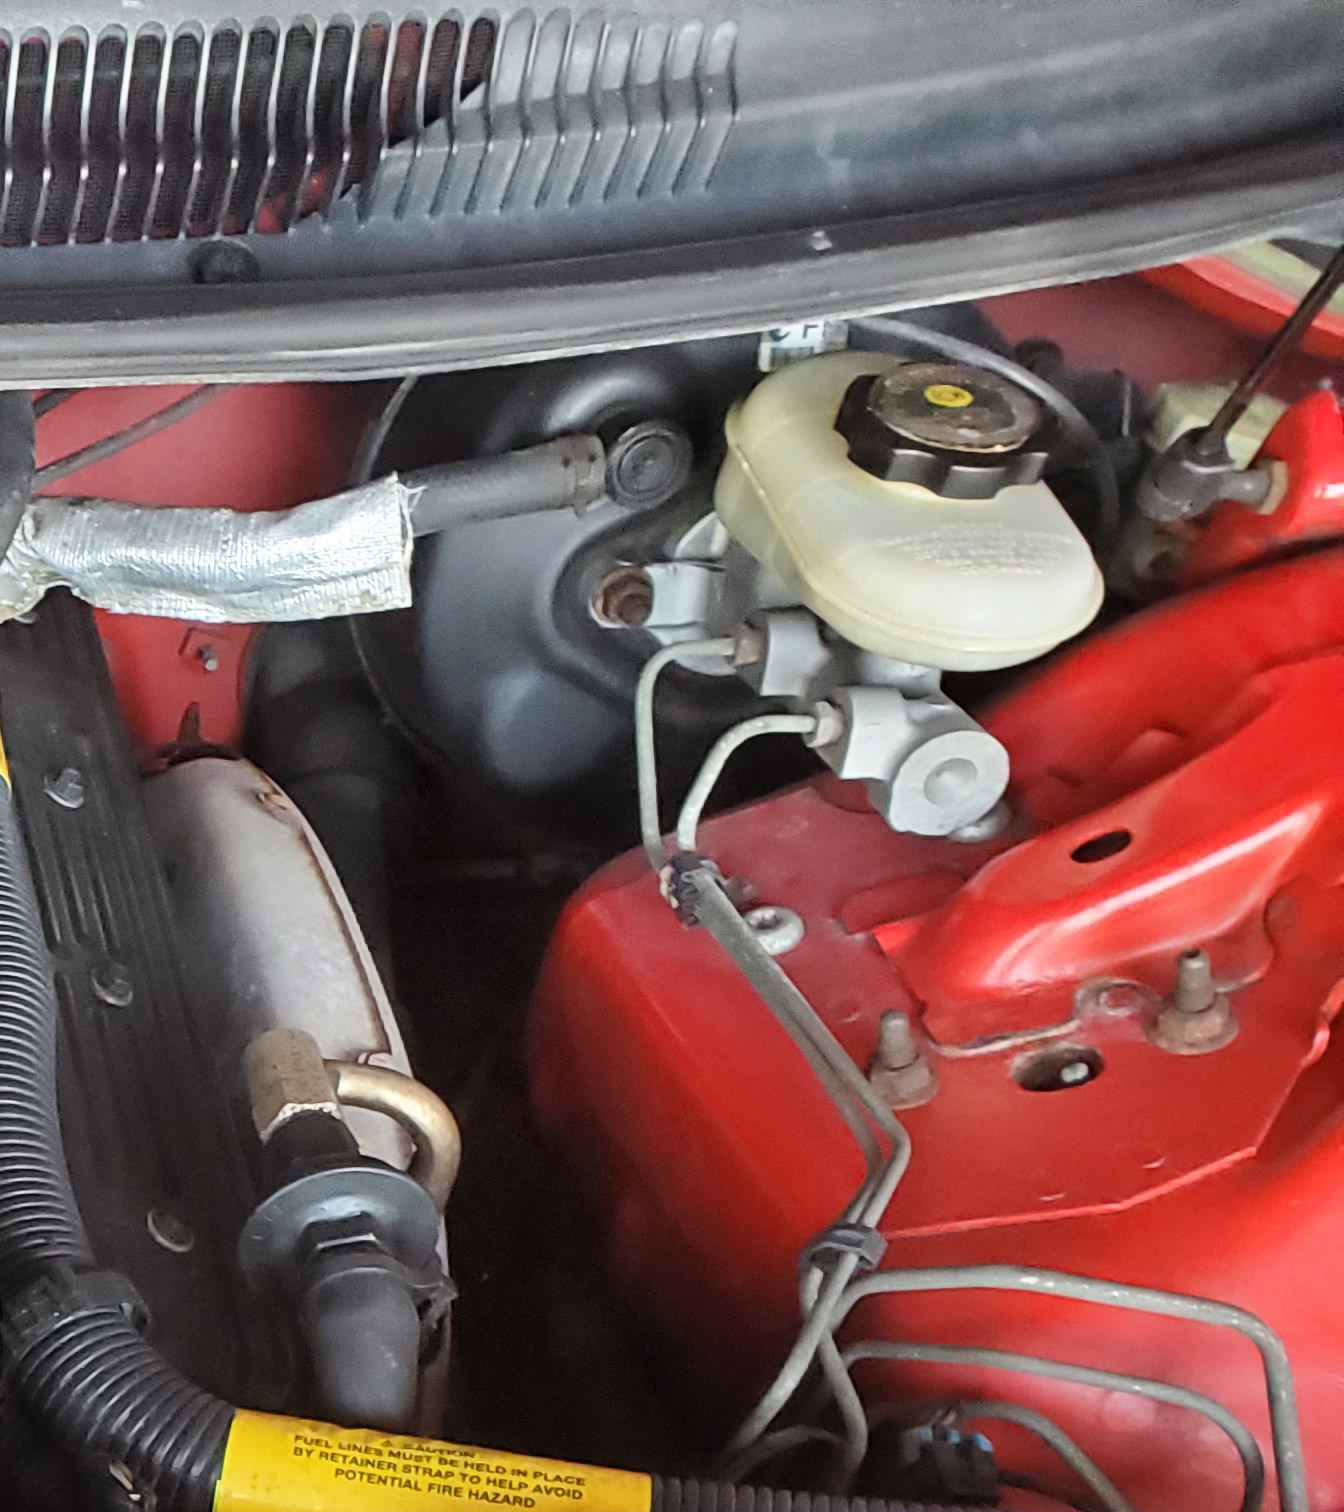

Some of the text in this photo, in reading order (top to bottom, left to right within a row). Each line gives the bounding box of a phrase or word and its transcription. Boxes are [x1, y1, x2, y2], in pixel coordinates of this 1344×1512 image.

[293, 1446, 583, 1500] BY RETAINER STRAP TO HELP AVOID
[294, 1434, 333, 1449] FUEL
[338, 1442, 383, 1457] LINES
[388, 1450, 433, 1463] MUST
[438, 1456, 459, 1468] BE
[463, 1460, 507, 1475] HELD
[510, 1468, 528, 1478] IN
[532, 1471, 586, 1486] PLACE
[334, 1468, 536, 1508] POTENTIAL FIRE HAZARD
